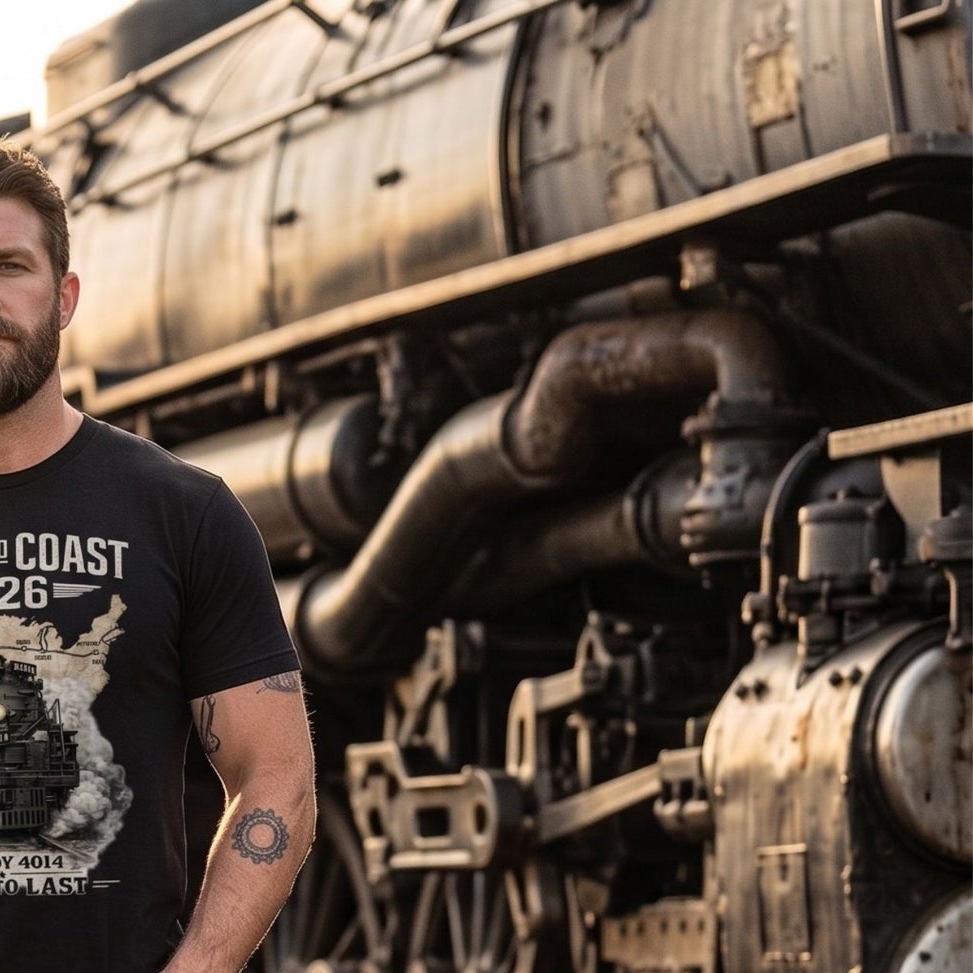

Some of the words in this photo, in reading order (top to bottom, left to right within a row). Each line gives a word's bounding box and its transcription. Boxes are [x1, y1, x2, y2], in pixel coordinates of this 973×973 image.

[15, 532, 129, 579] COAST
[18, 855, 64, 869] 4014
[26, 876, 88, 896] LAST
